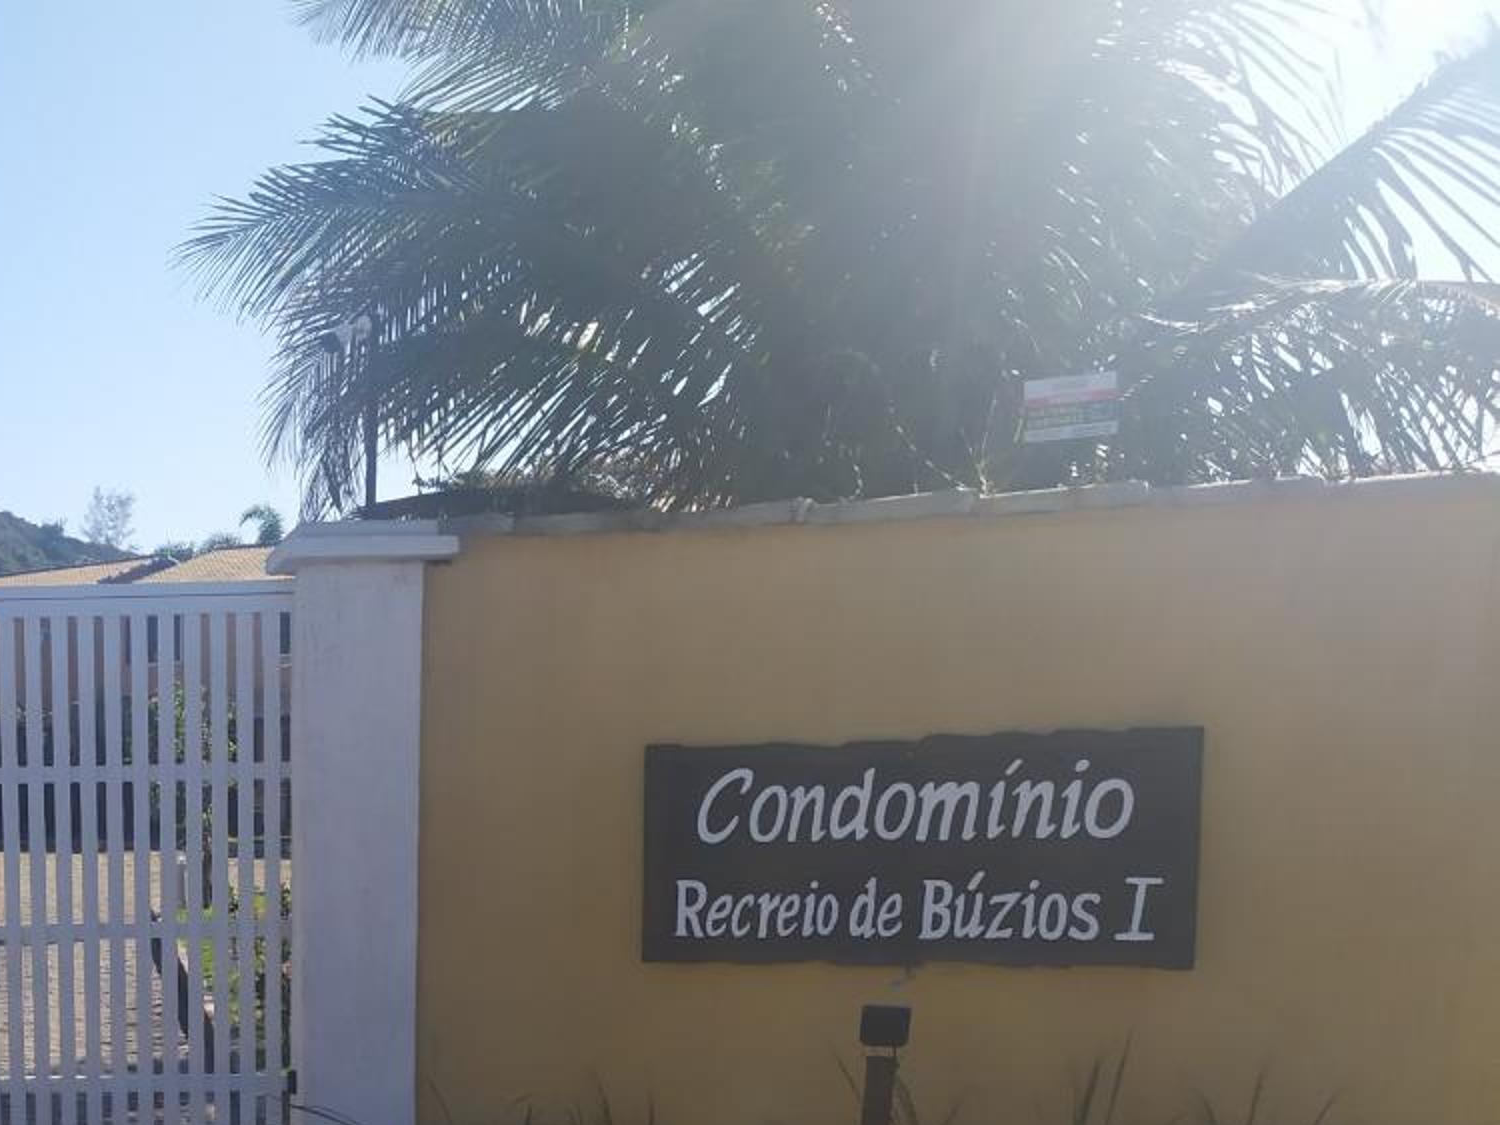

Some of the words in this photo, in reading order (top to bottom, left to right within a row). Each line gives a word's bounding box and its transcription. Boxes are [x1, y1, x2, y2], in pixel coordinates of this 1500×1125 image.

[697, 758, 1134, 843] Condomínio
[675, 879, 838, 939] Recreio
[850, 877, 904, 939] de
[919, 871, 1101, 941] Búzios
[1115, 877, 1164, 941] I
